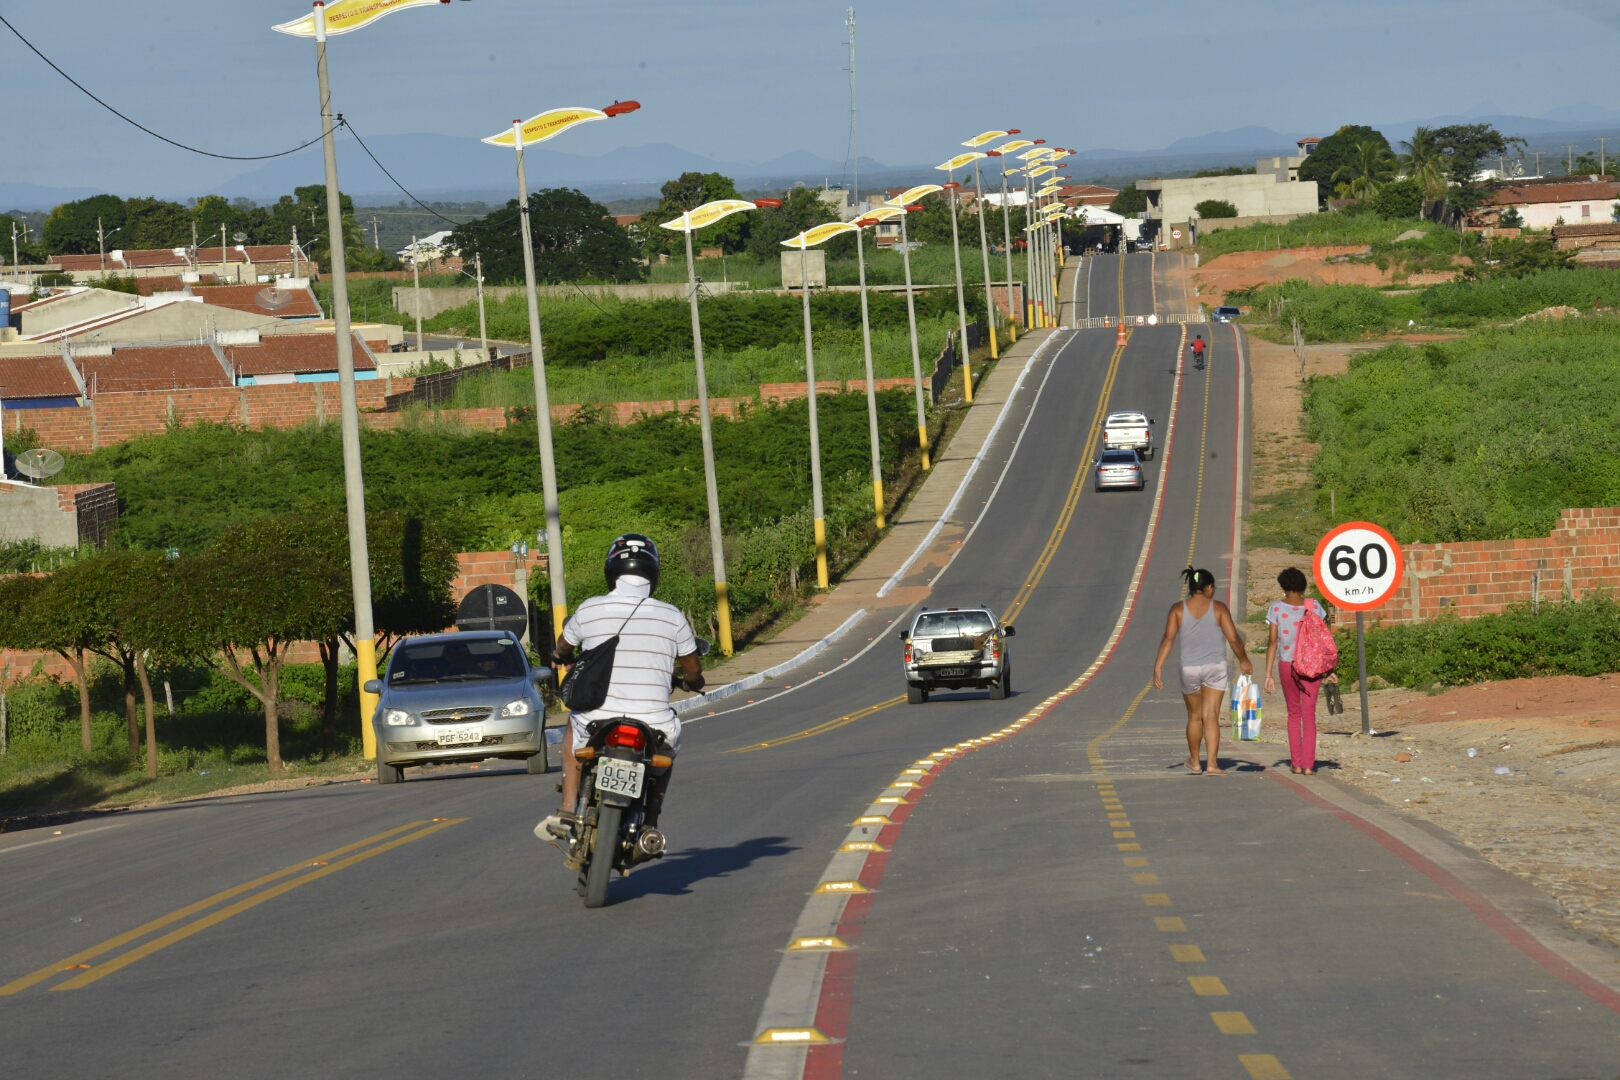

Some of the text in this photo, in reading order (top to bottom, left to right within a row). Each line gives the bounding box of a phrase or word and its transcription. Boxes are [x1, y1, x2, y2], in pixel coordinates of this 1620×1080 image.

[1328, 543, 1388, 581] 60
[1345, 586, 1374, 596] km/h
[601, 776, 636, 794] 8274
